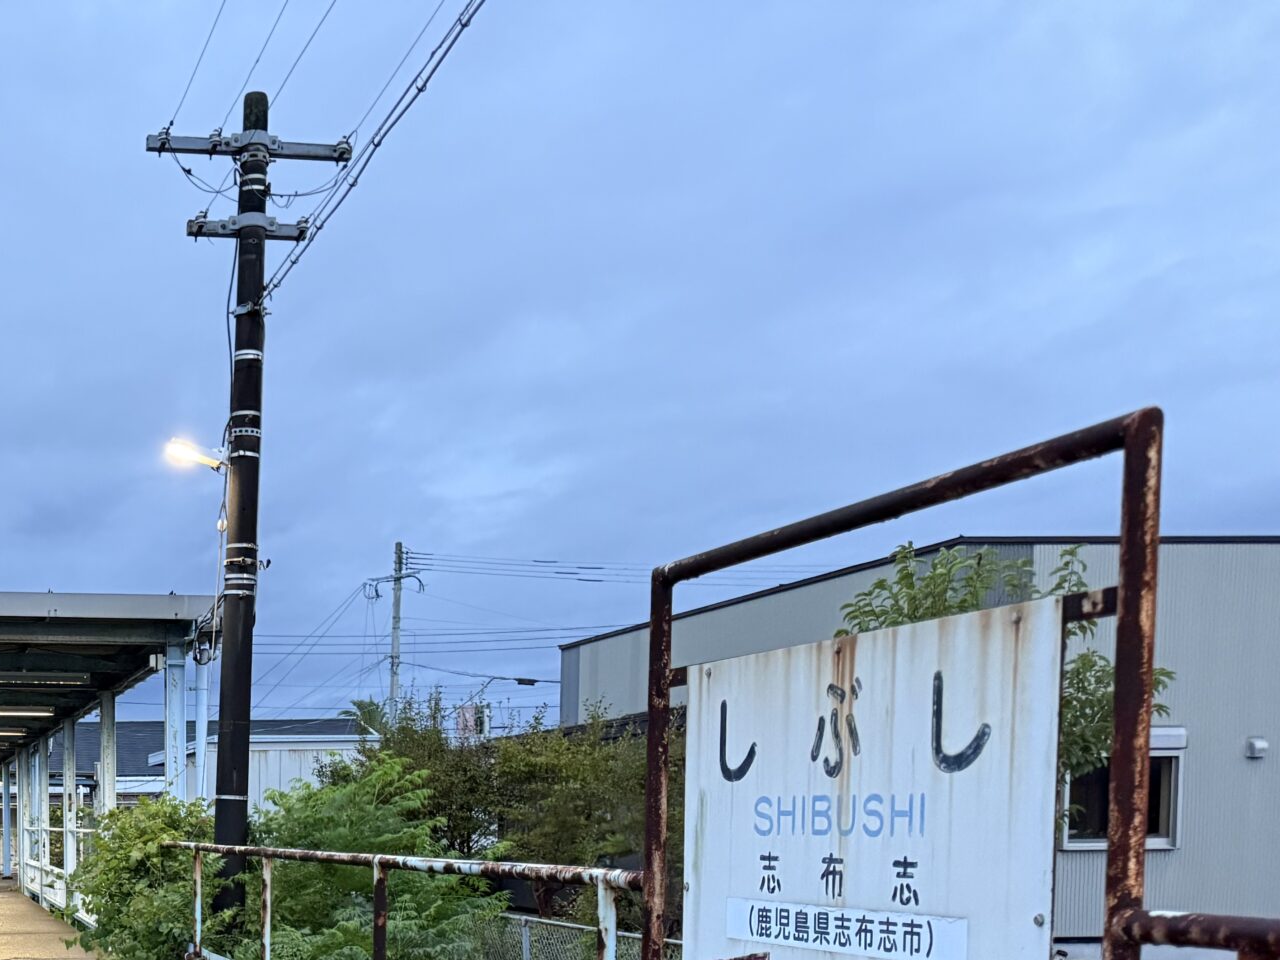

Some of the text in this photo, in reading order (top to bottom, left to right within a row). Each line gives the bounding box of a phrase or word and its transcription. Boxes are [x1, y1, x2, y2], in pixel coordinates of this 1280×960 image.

[719, 669, 992, 783] しぶし
[753, 792, 927, 838] SHIBUSHI
[758, 850, 920, 906] 志布志
[748, 904, 934, 958] (鹿児島県志布志市)
